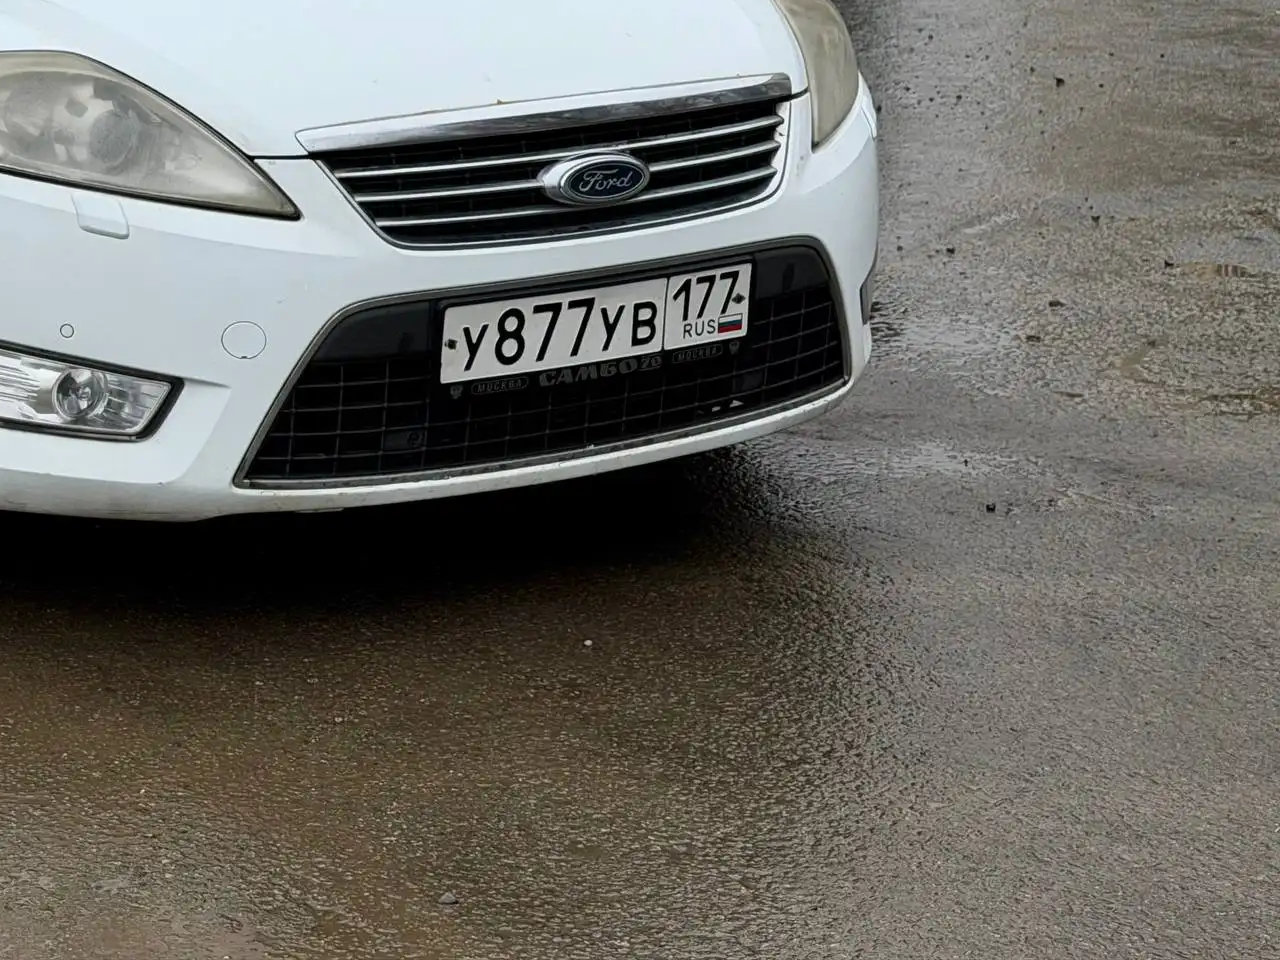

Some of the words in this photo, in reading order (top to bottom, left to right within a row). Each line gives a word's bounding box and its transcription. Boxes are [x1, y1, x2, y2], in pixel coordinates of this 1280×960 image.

[578, 168, 634, 192] Ford
[462, 296, 658, 371] У877УВ
[672, 270, 740, 321] 177
[682, 318, 716, 339] RUS
